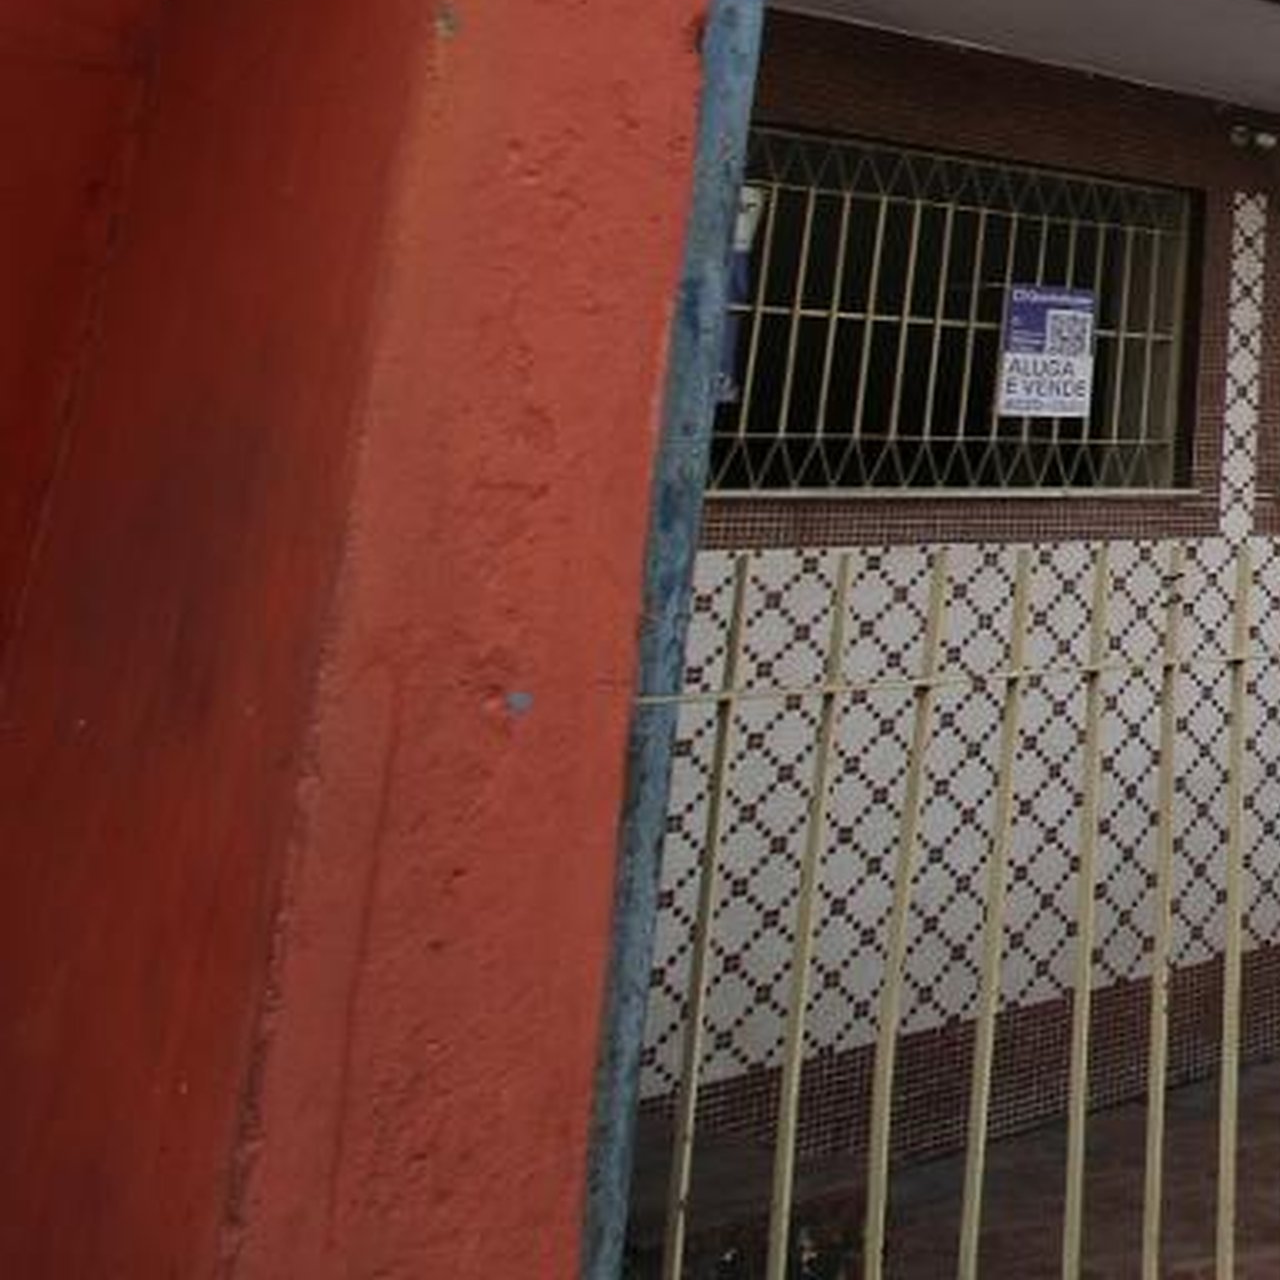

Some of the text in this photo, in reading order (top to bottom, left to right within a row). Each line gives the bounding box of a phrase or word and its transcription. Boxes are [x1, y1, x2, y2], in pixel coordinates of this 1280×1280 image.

[1008, 358, 1074, 378] ALUGA
[1005, 378, 1086, 398] E VENDE
